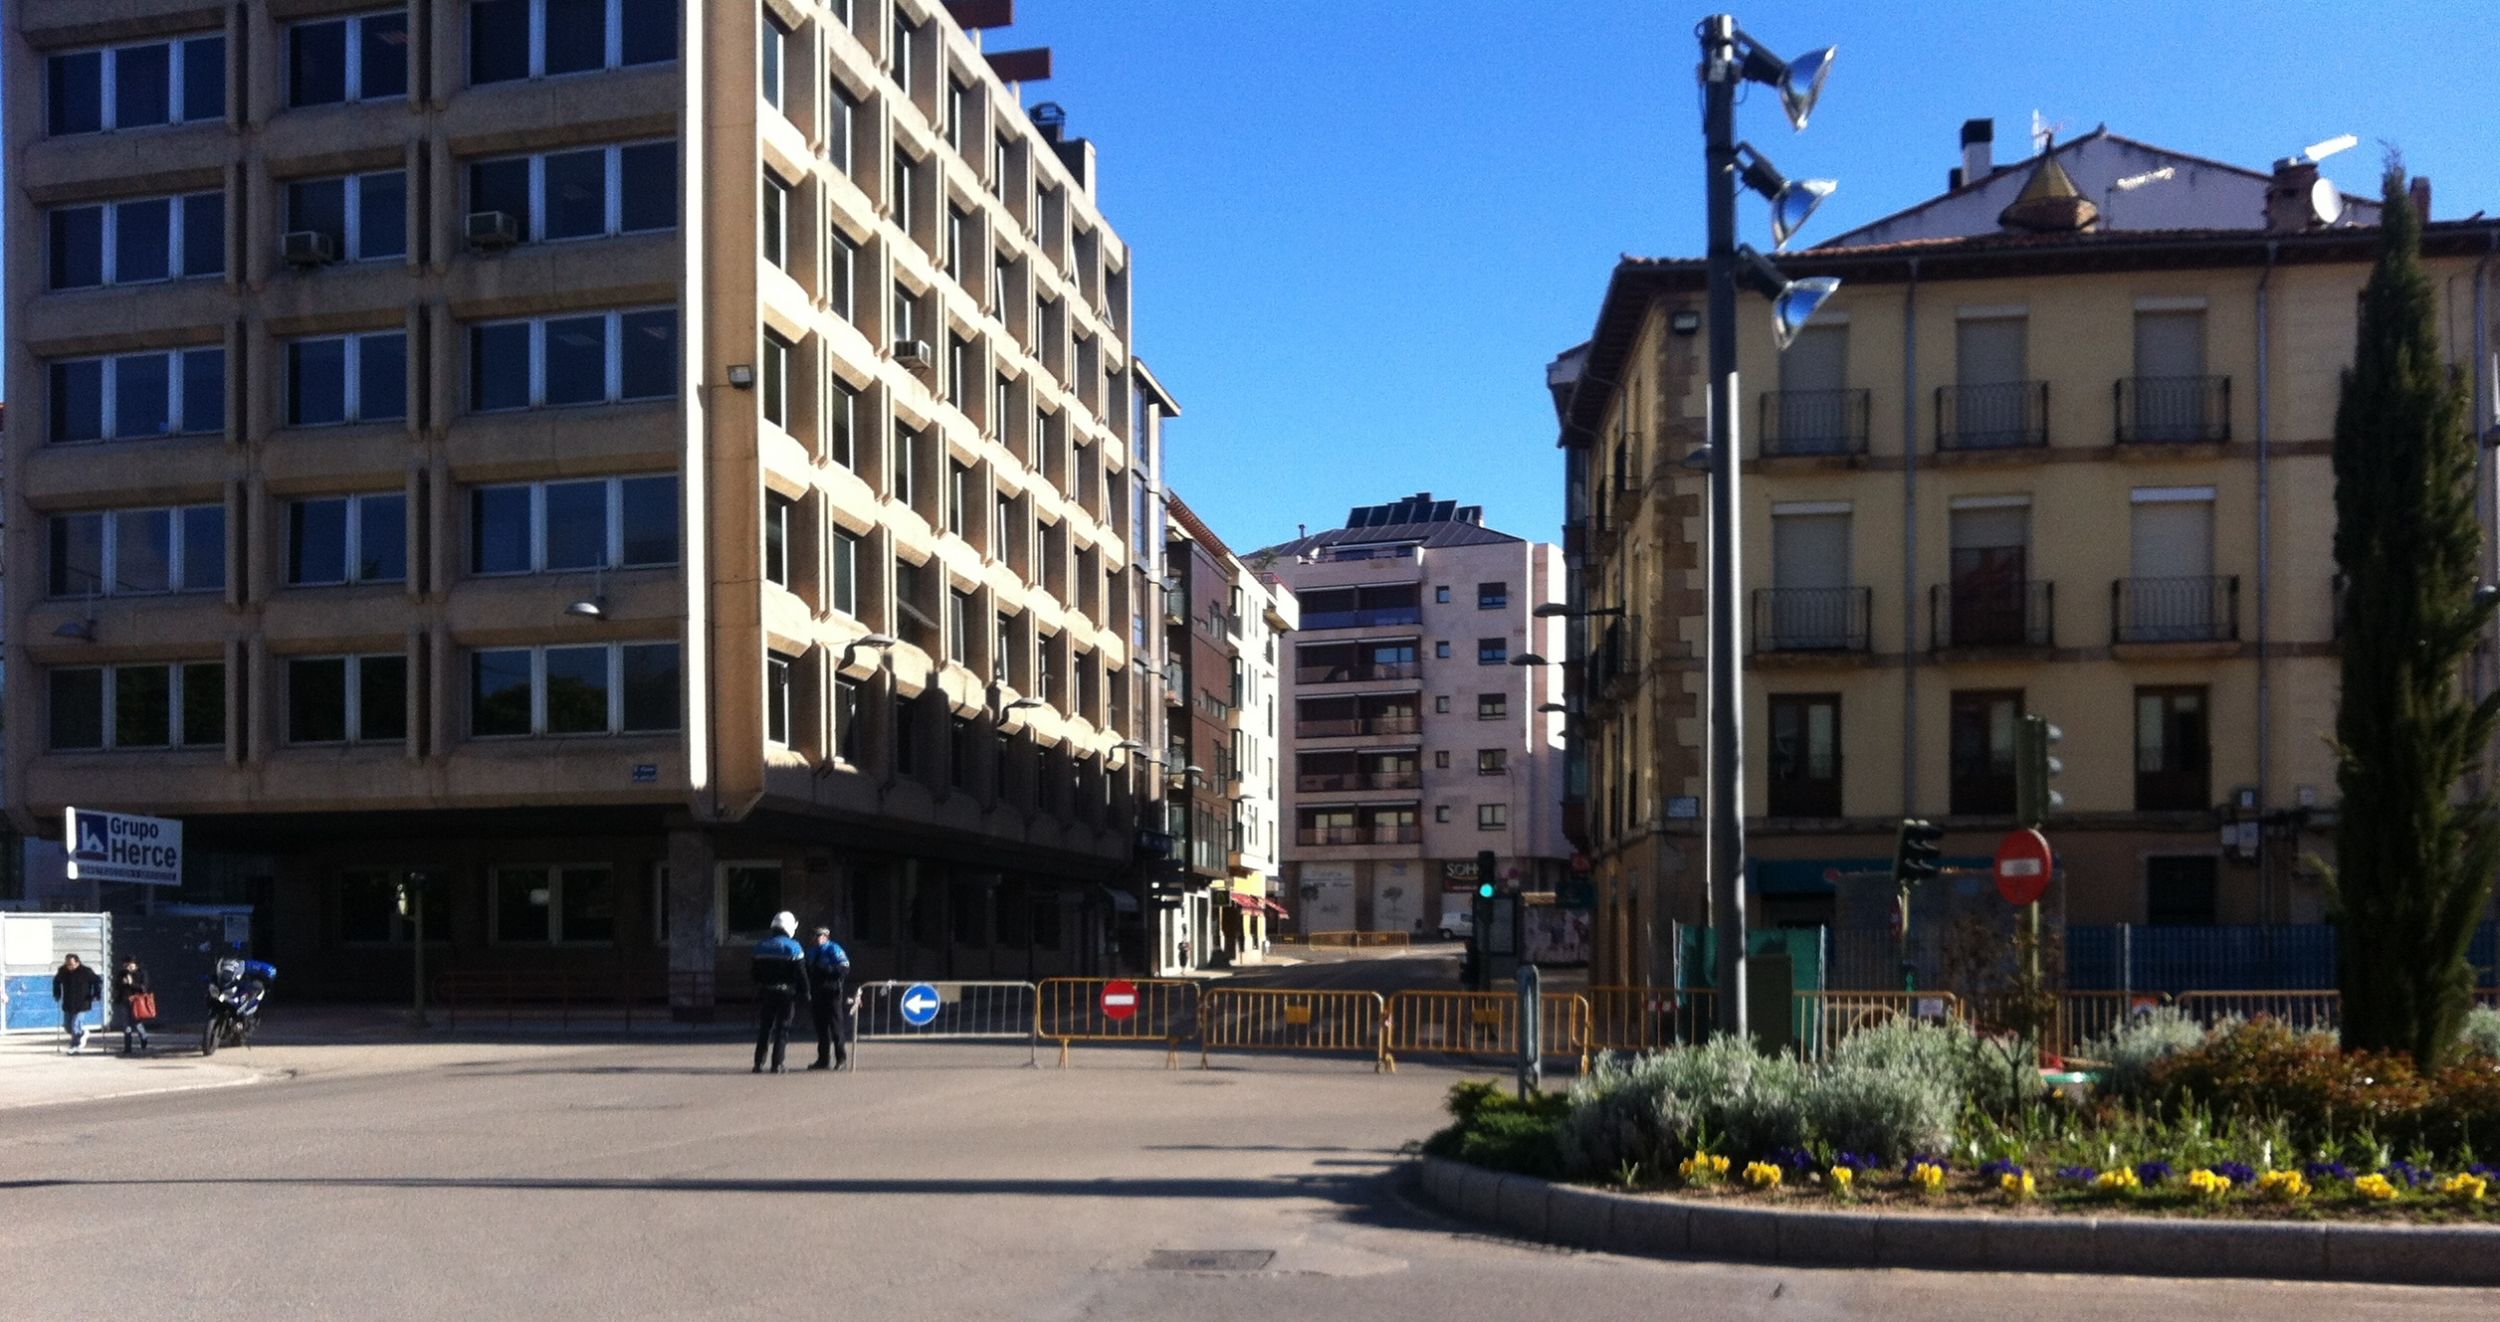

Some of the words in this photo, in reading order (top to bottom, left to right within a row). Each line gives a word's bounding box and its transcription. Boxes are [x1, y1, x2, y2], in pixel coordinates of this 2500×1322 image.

[110, 817, 159, 840] Grupo
[111, 838, 177, 868] Herce
[1446, 862, 1479, 877] SOH
